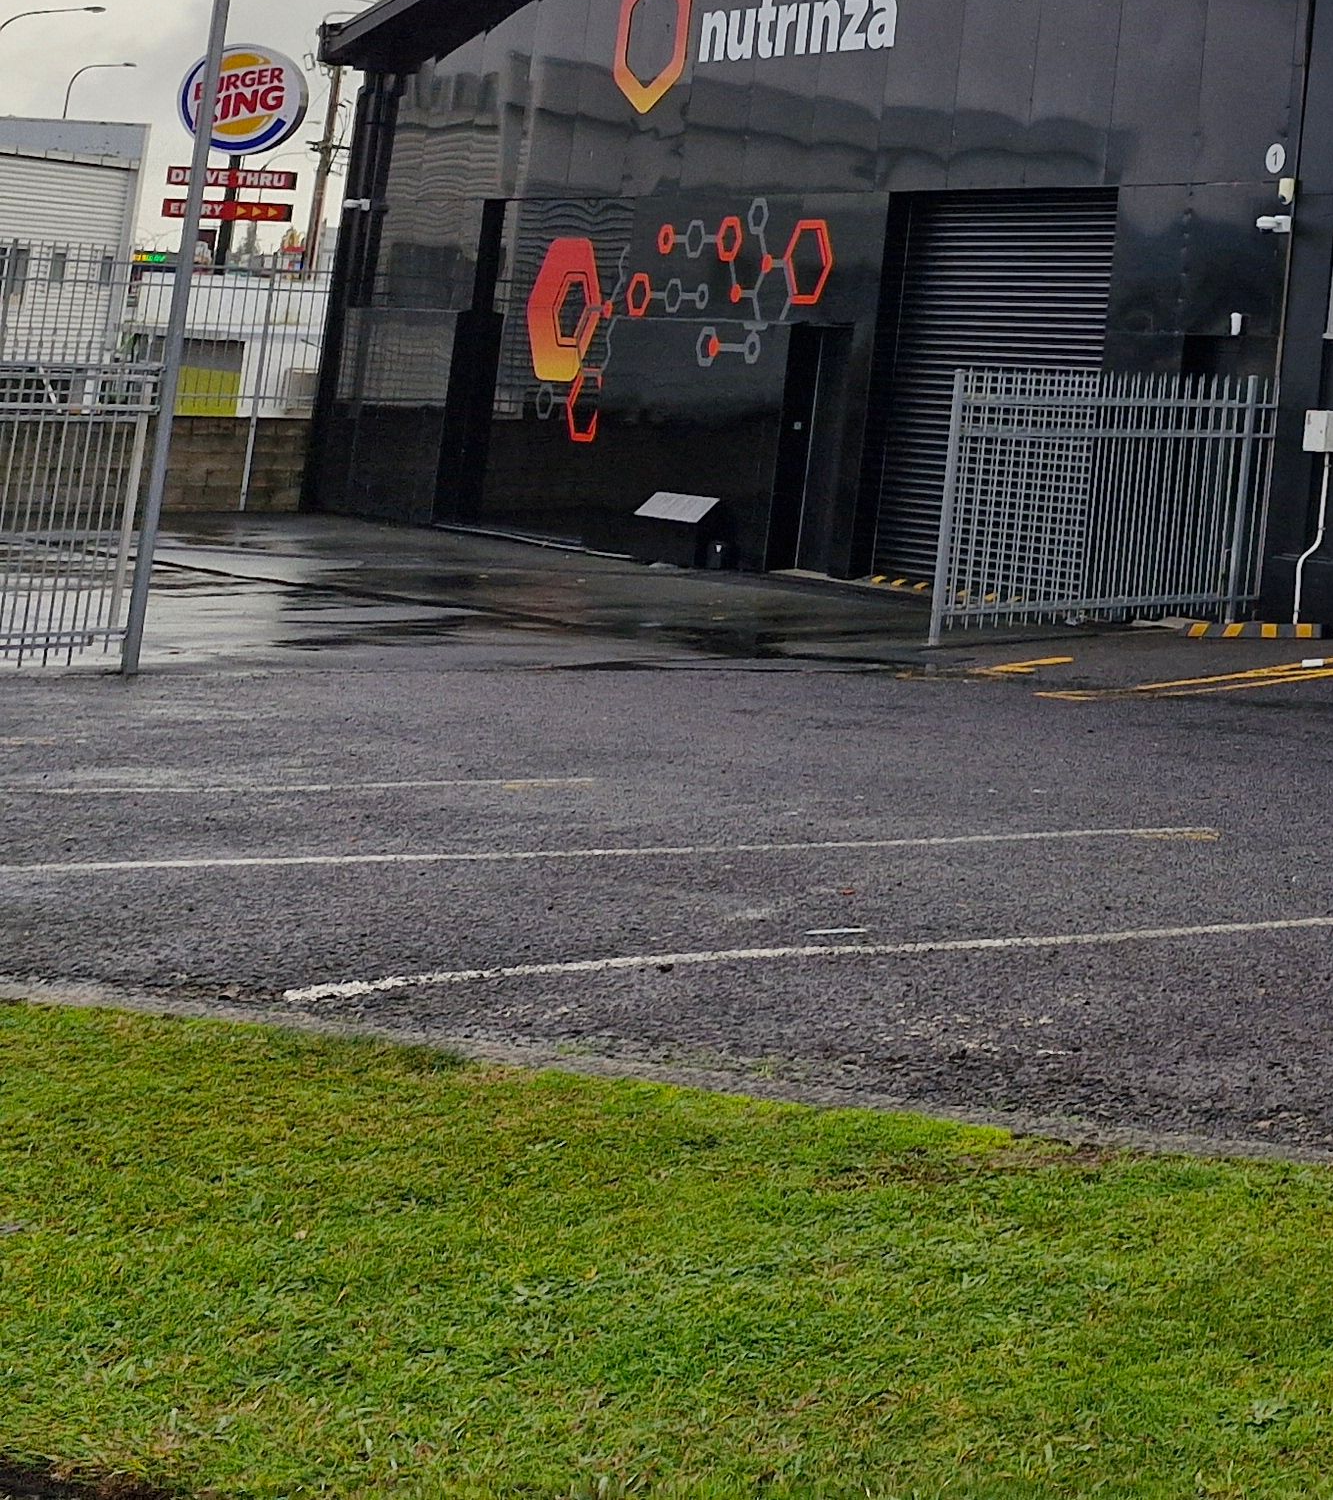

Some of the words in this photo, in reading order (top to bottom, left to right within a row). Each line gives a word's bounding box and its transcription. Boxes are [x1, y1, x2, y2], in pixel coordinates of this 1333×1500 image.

[170, 169, 229, 184] DVE
[236, 171, 286, 186] THRU
[170, 202, 224, 216] ERY
